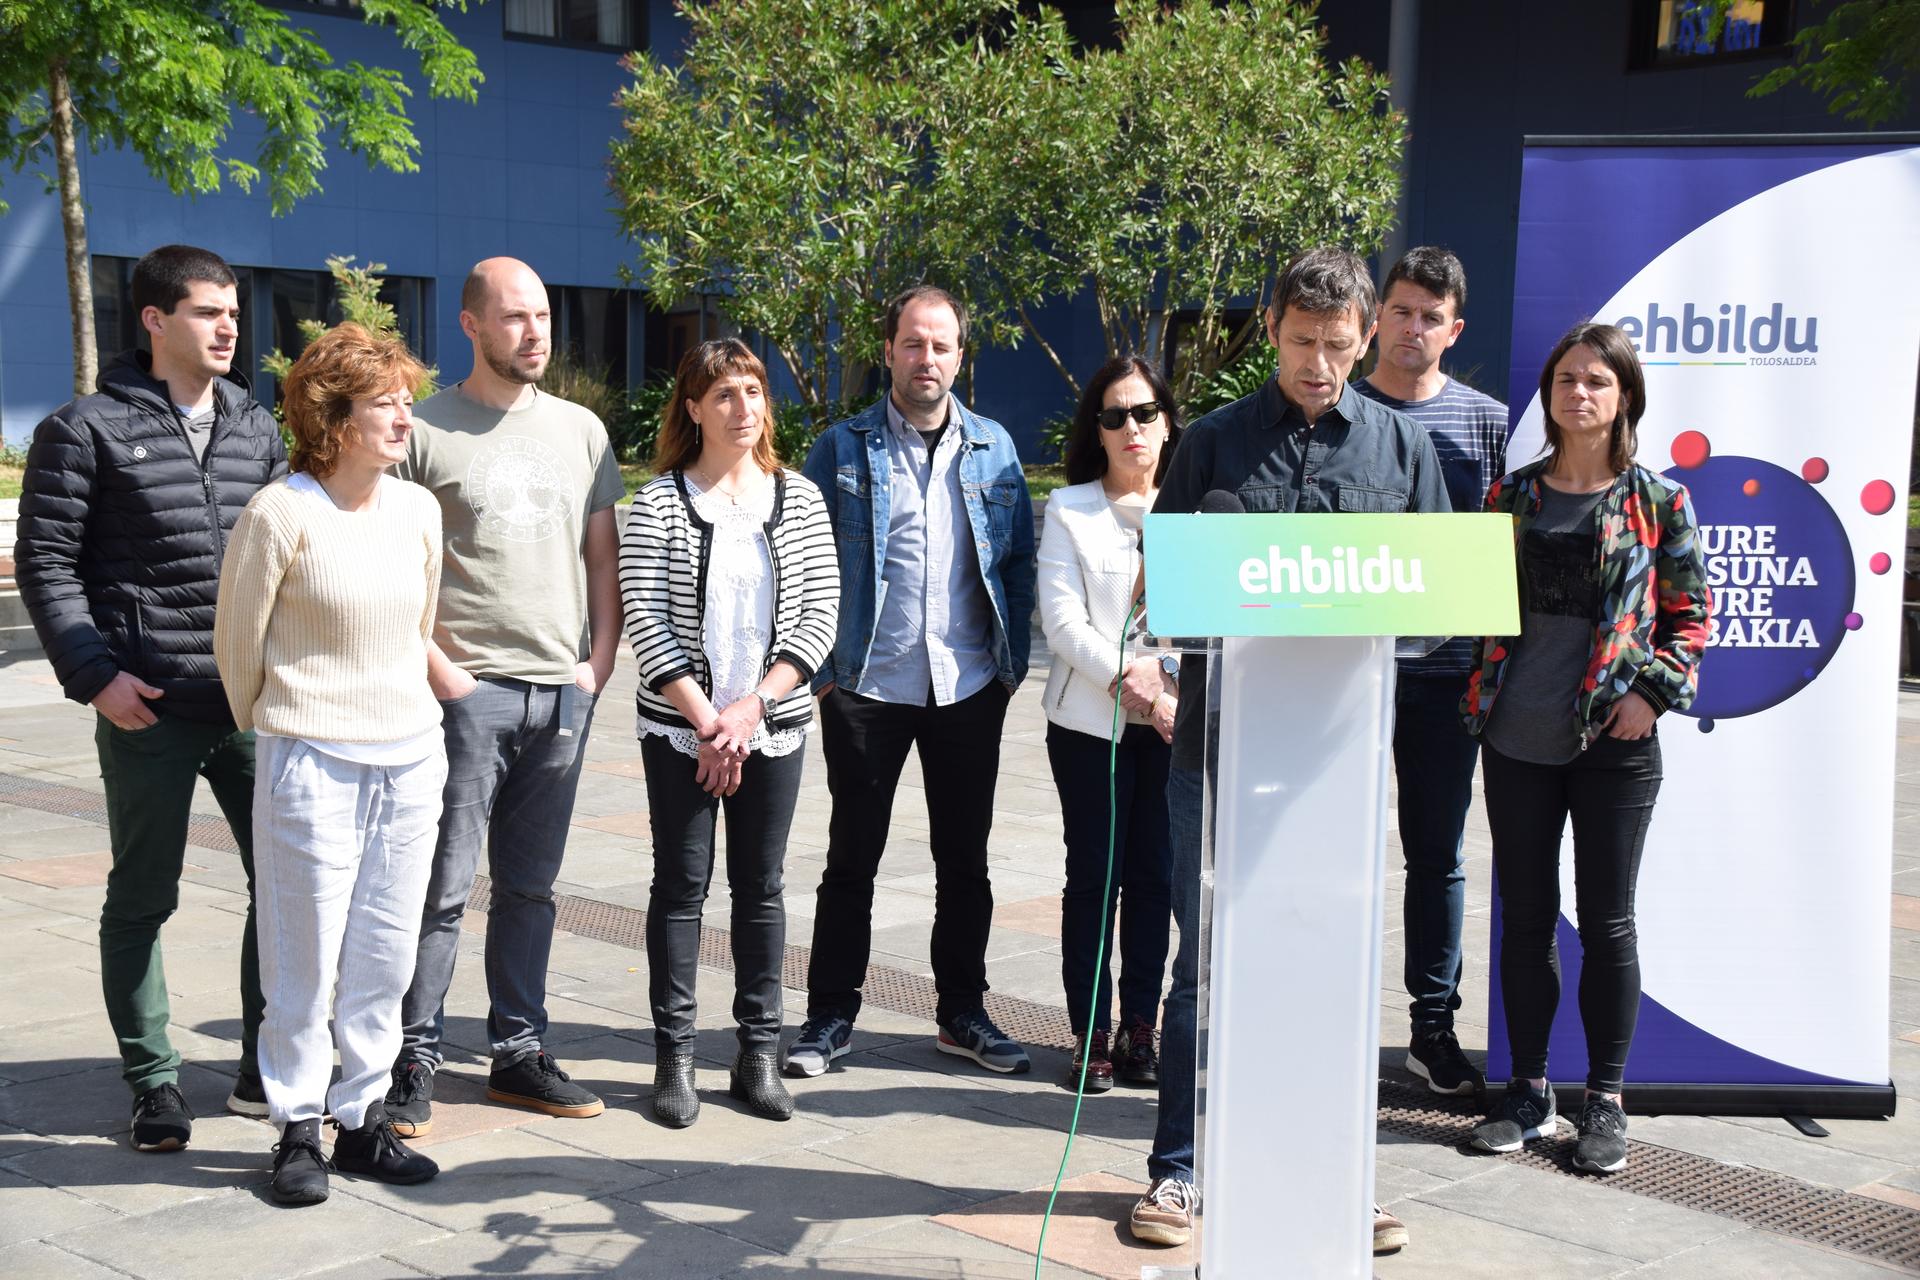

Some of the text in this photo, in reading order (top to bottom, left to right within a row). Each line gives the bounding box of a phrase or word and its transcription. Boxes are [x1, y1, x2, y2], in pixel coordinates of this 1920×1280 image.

[1614, 302, 1818, 354] ehbildu
[1749, 357, 1817, 367] TOLOSALDEA
[1698, 525, 1777, 555] URE
[1238, 545, 1425, 594] ehbildu
[1706, 556, 1819, 587] SUNA
[1704, 618, 1821, 648] BAKIA
